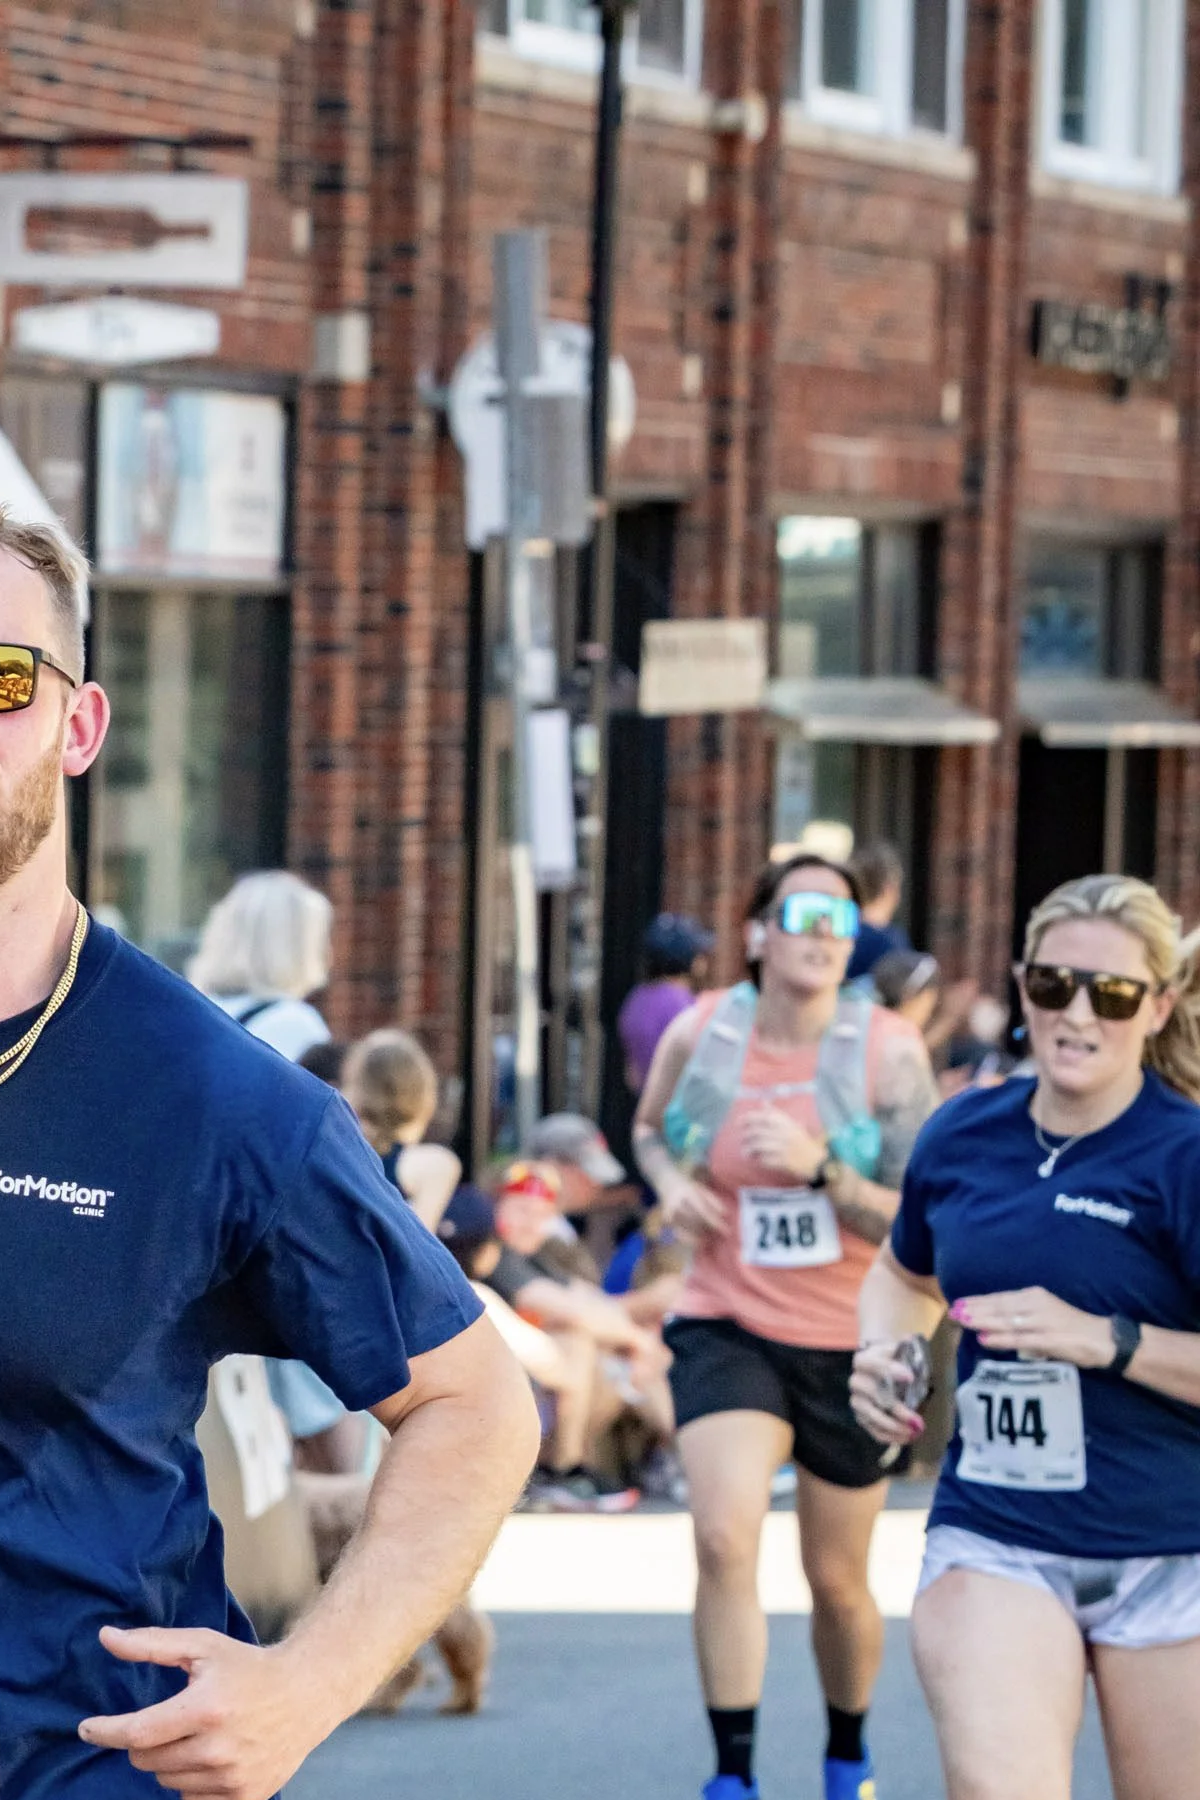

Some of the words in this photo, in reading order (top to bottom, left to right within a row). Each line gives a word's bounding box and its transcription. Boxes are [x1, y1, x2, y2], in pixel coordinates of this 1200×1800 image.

[72, 1206, 105, 1218] CLINIC
[756, 1213, 816, 1249] 248
[977, 1392, 1047, 1447] 744
